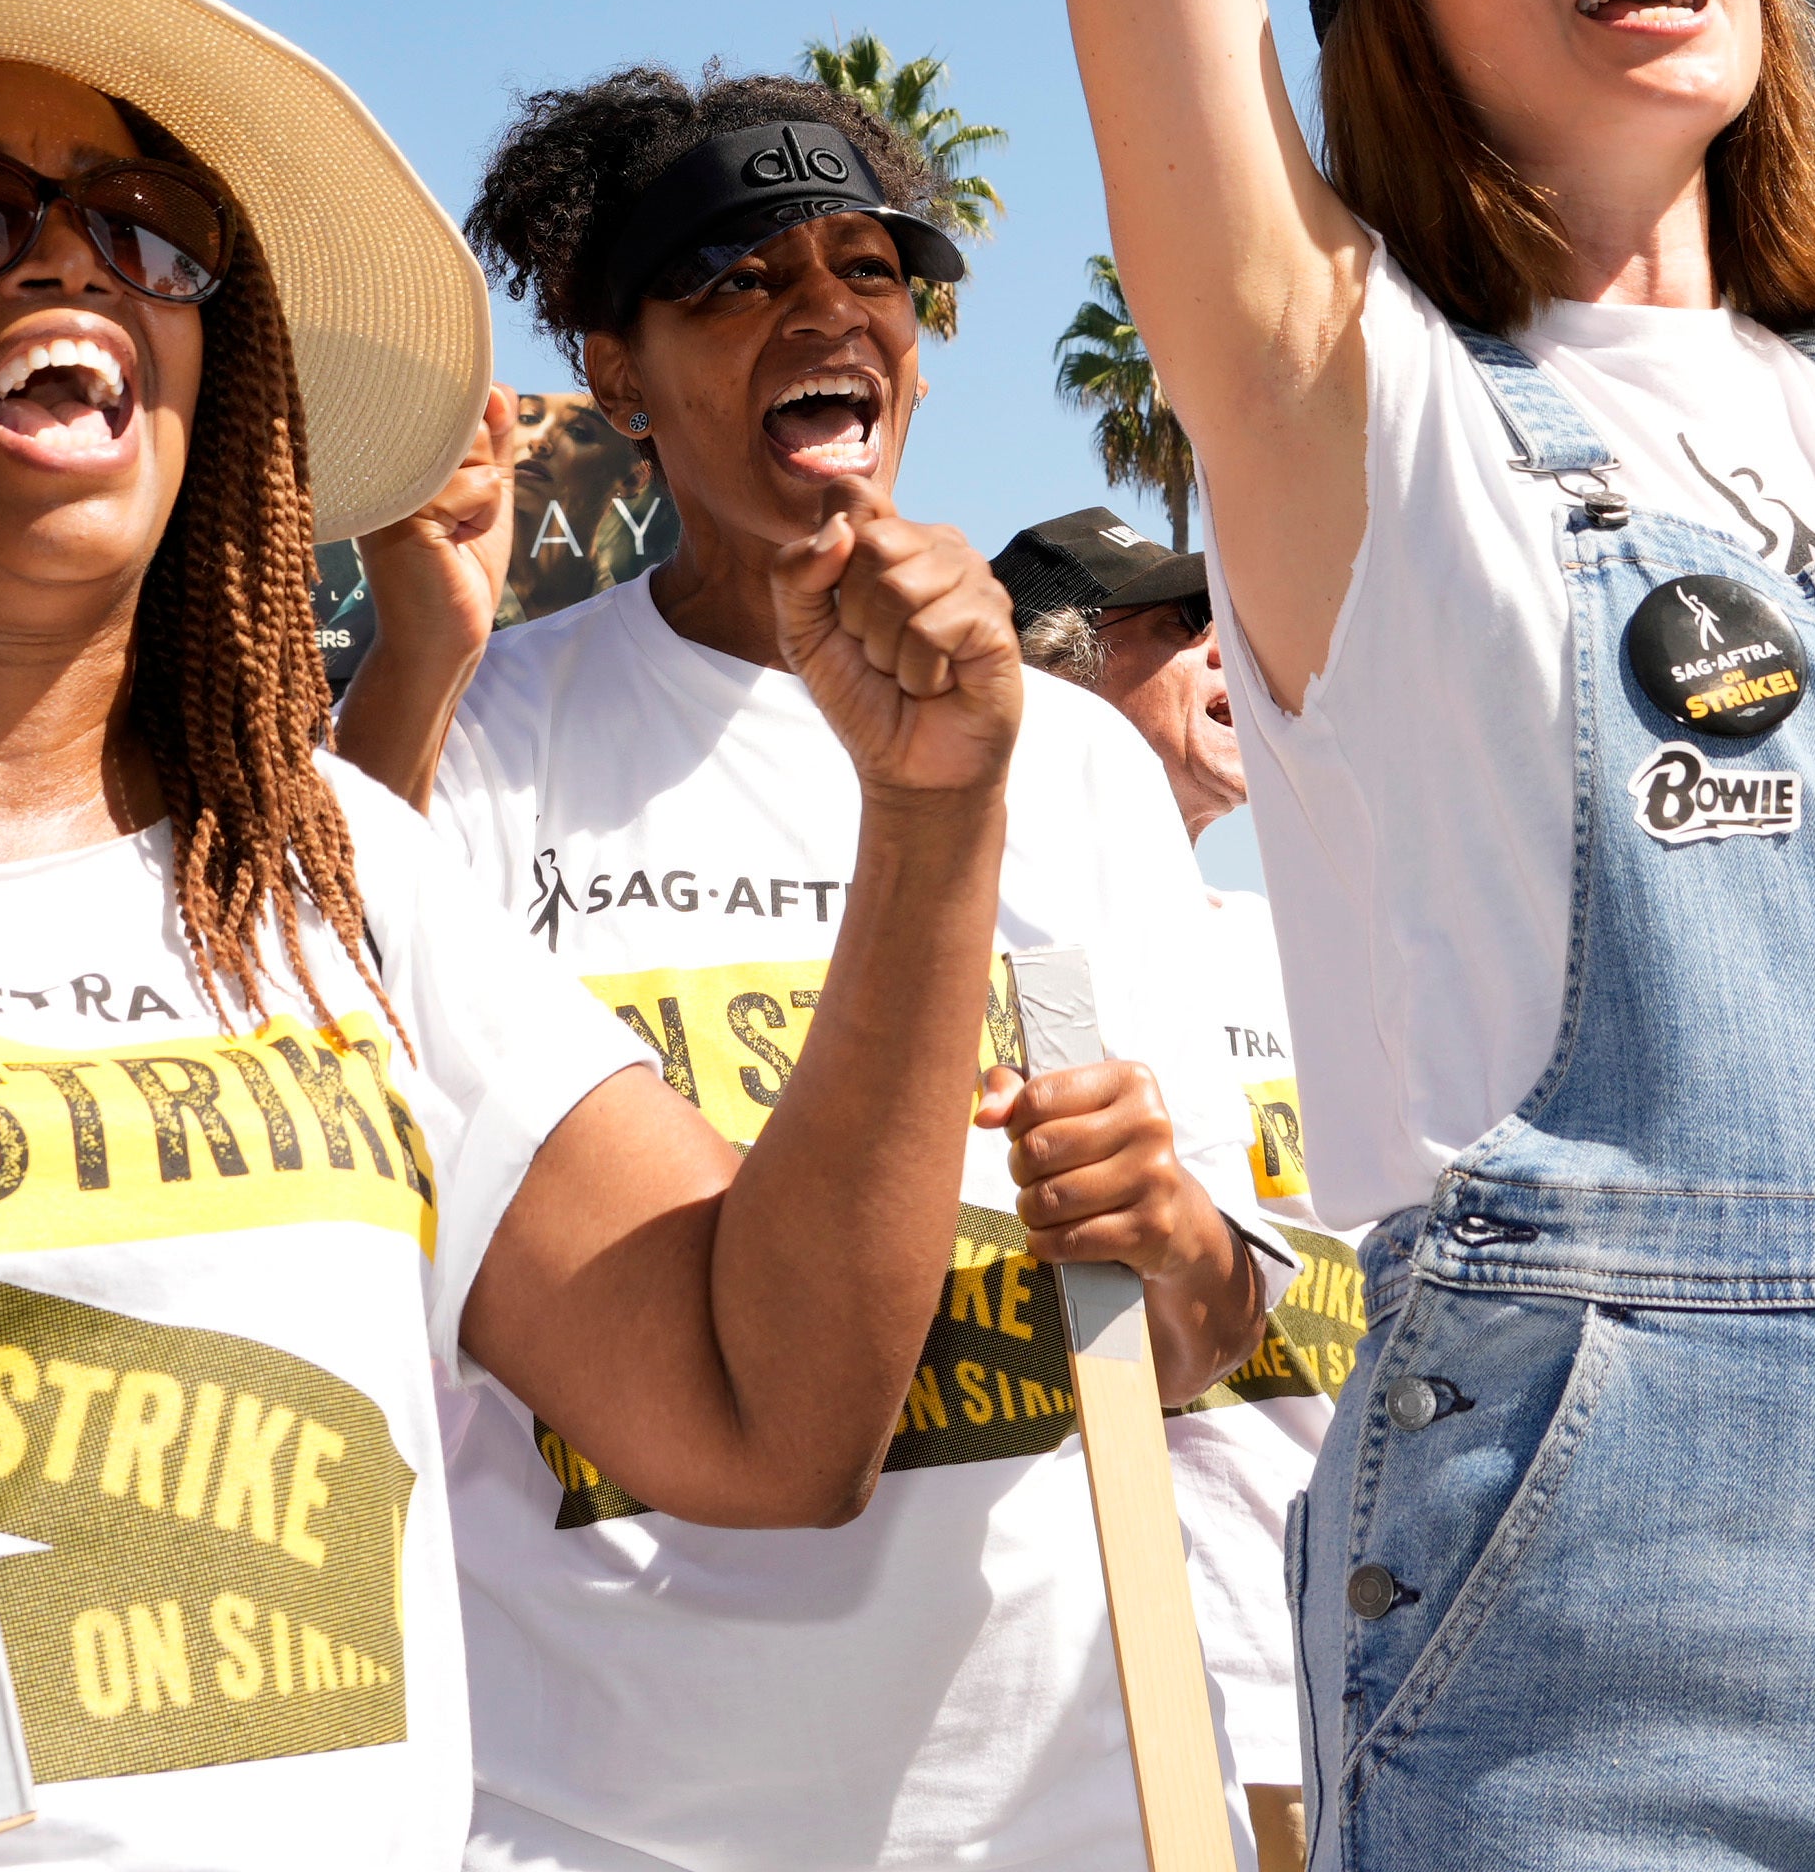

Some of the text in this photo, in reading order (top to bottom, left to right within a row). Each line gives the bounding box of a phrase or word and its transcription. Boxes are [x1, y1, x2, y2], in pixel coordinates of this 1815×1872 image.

[741, 126, 849, 188] alo
[1685, 669, 1799, 720] STRIKE!
[1721, 669, 1746, 685] ON
[587, 870, 852, 923] SAG·AFT
[72, 1597, 193, 1718] ON
